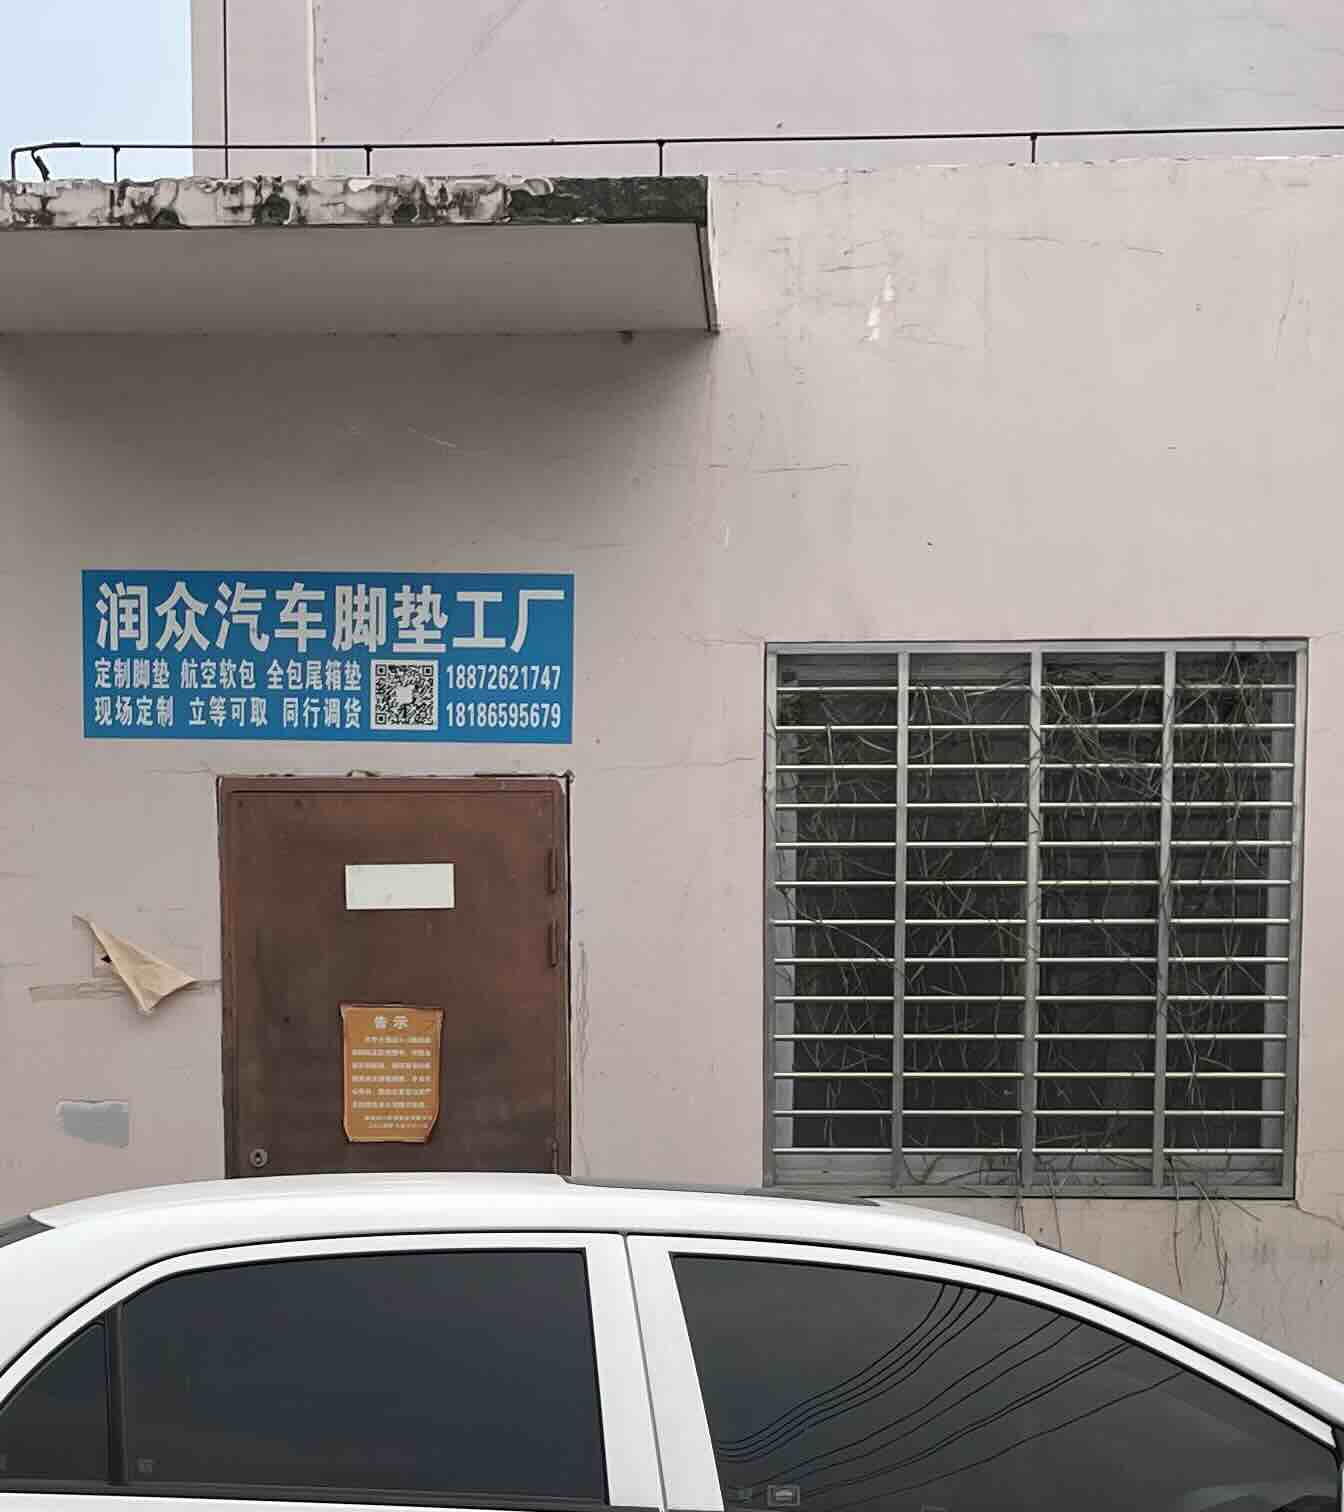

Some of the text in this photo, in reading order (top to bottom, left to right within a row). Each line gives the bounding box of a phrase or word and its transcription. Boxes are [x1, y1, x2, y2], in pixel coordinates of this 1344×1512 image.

[95, 581, 566, 654] 润众汽车脚垫工厂
[94, 658, 362, 692] 定制脚垫 航空软包 全包尾箱垫
[445, 664, 562, 691] 18872621747
[94, 695, 362, 729] 现场定制 立等可取 同行调货
[445, 702, 562, 728] 18186595679
